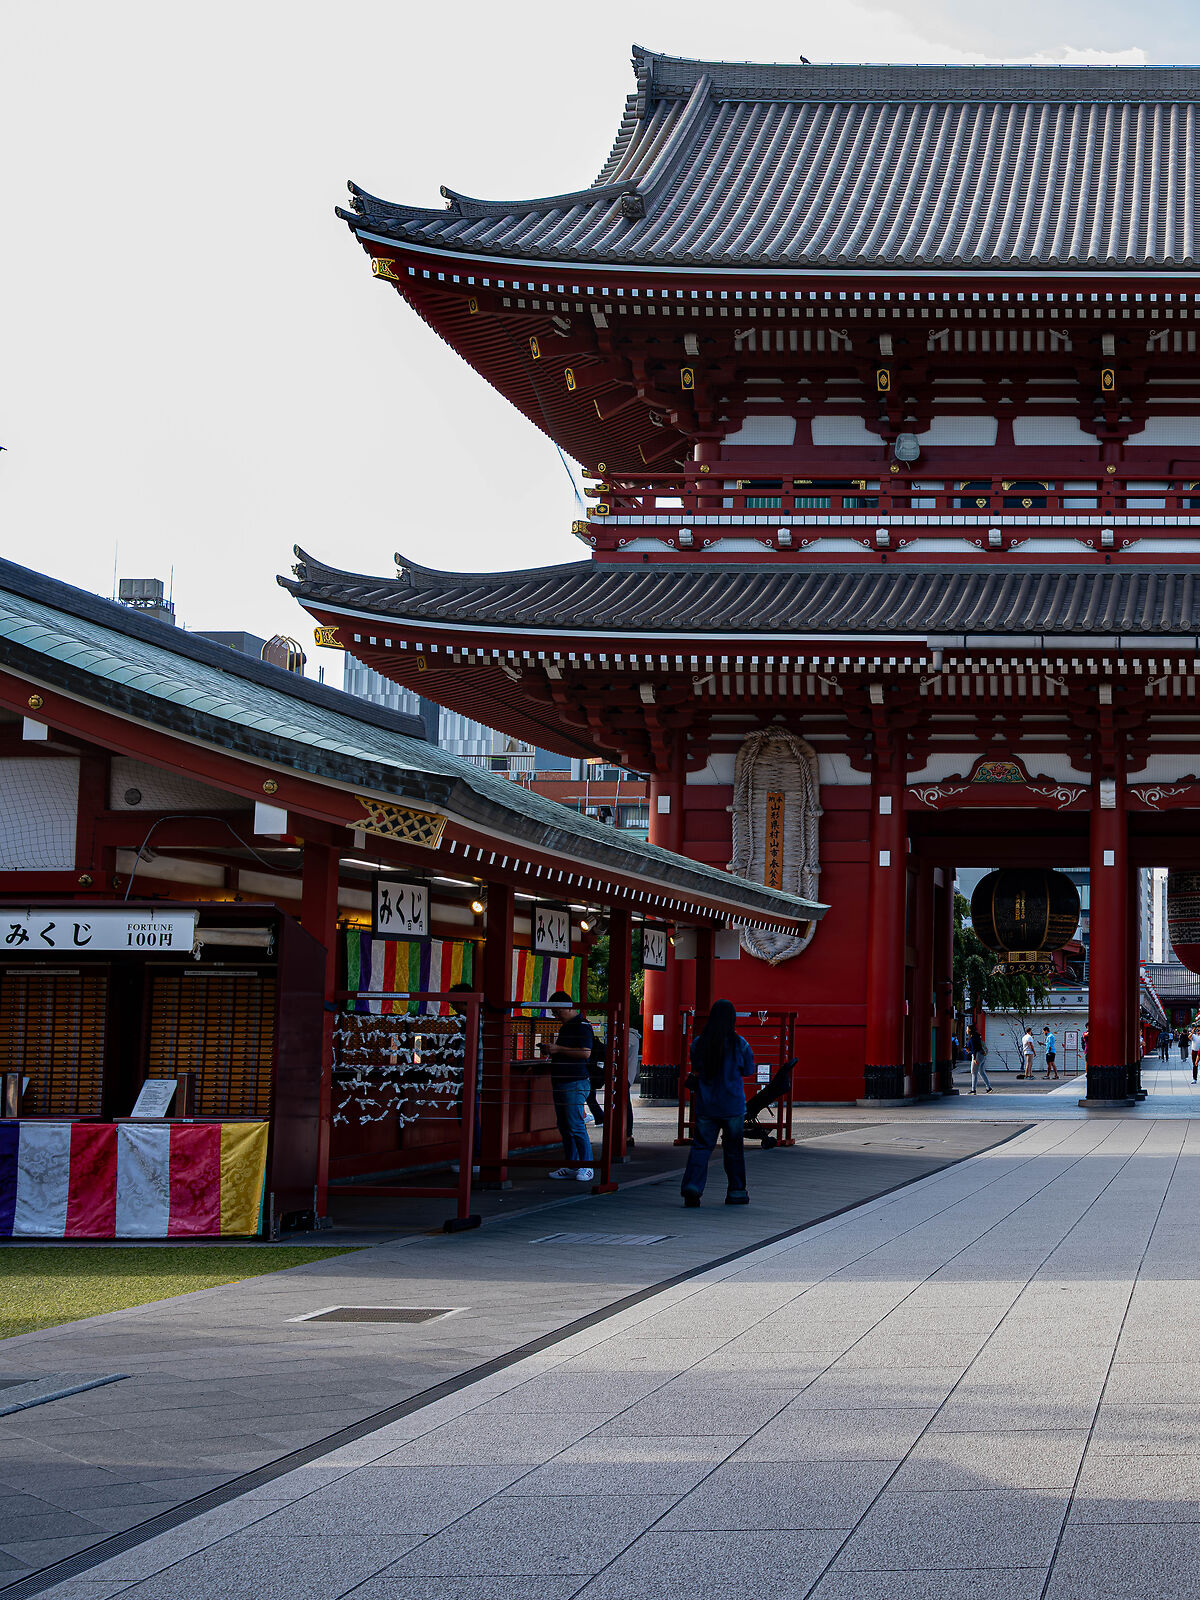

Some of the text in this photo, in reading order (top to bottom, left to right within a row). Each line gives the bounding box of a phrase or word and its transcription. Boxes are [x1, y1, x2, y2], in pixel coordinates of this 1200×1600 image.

[380, 889, 422, 926] みくじ
[5, 922, 93, 947] みくじ
[127, 923, 173, 931] FORTUNE
[127, 932, 173, 947] 100円
[537, 915, 565, 944] みくじ
